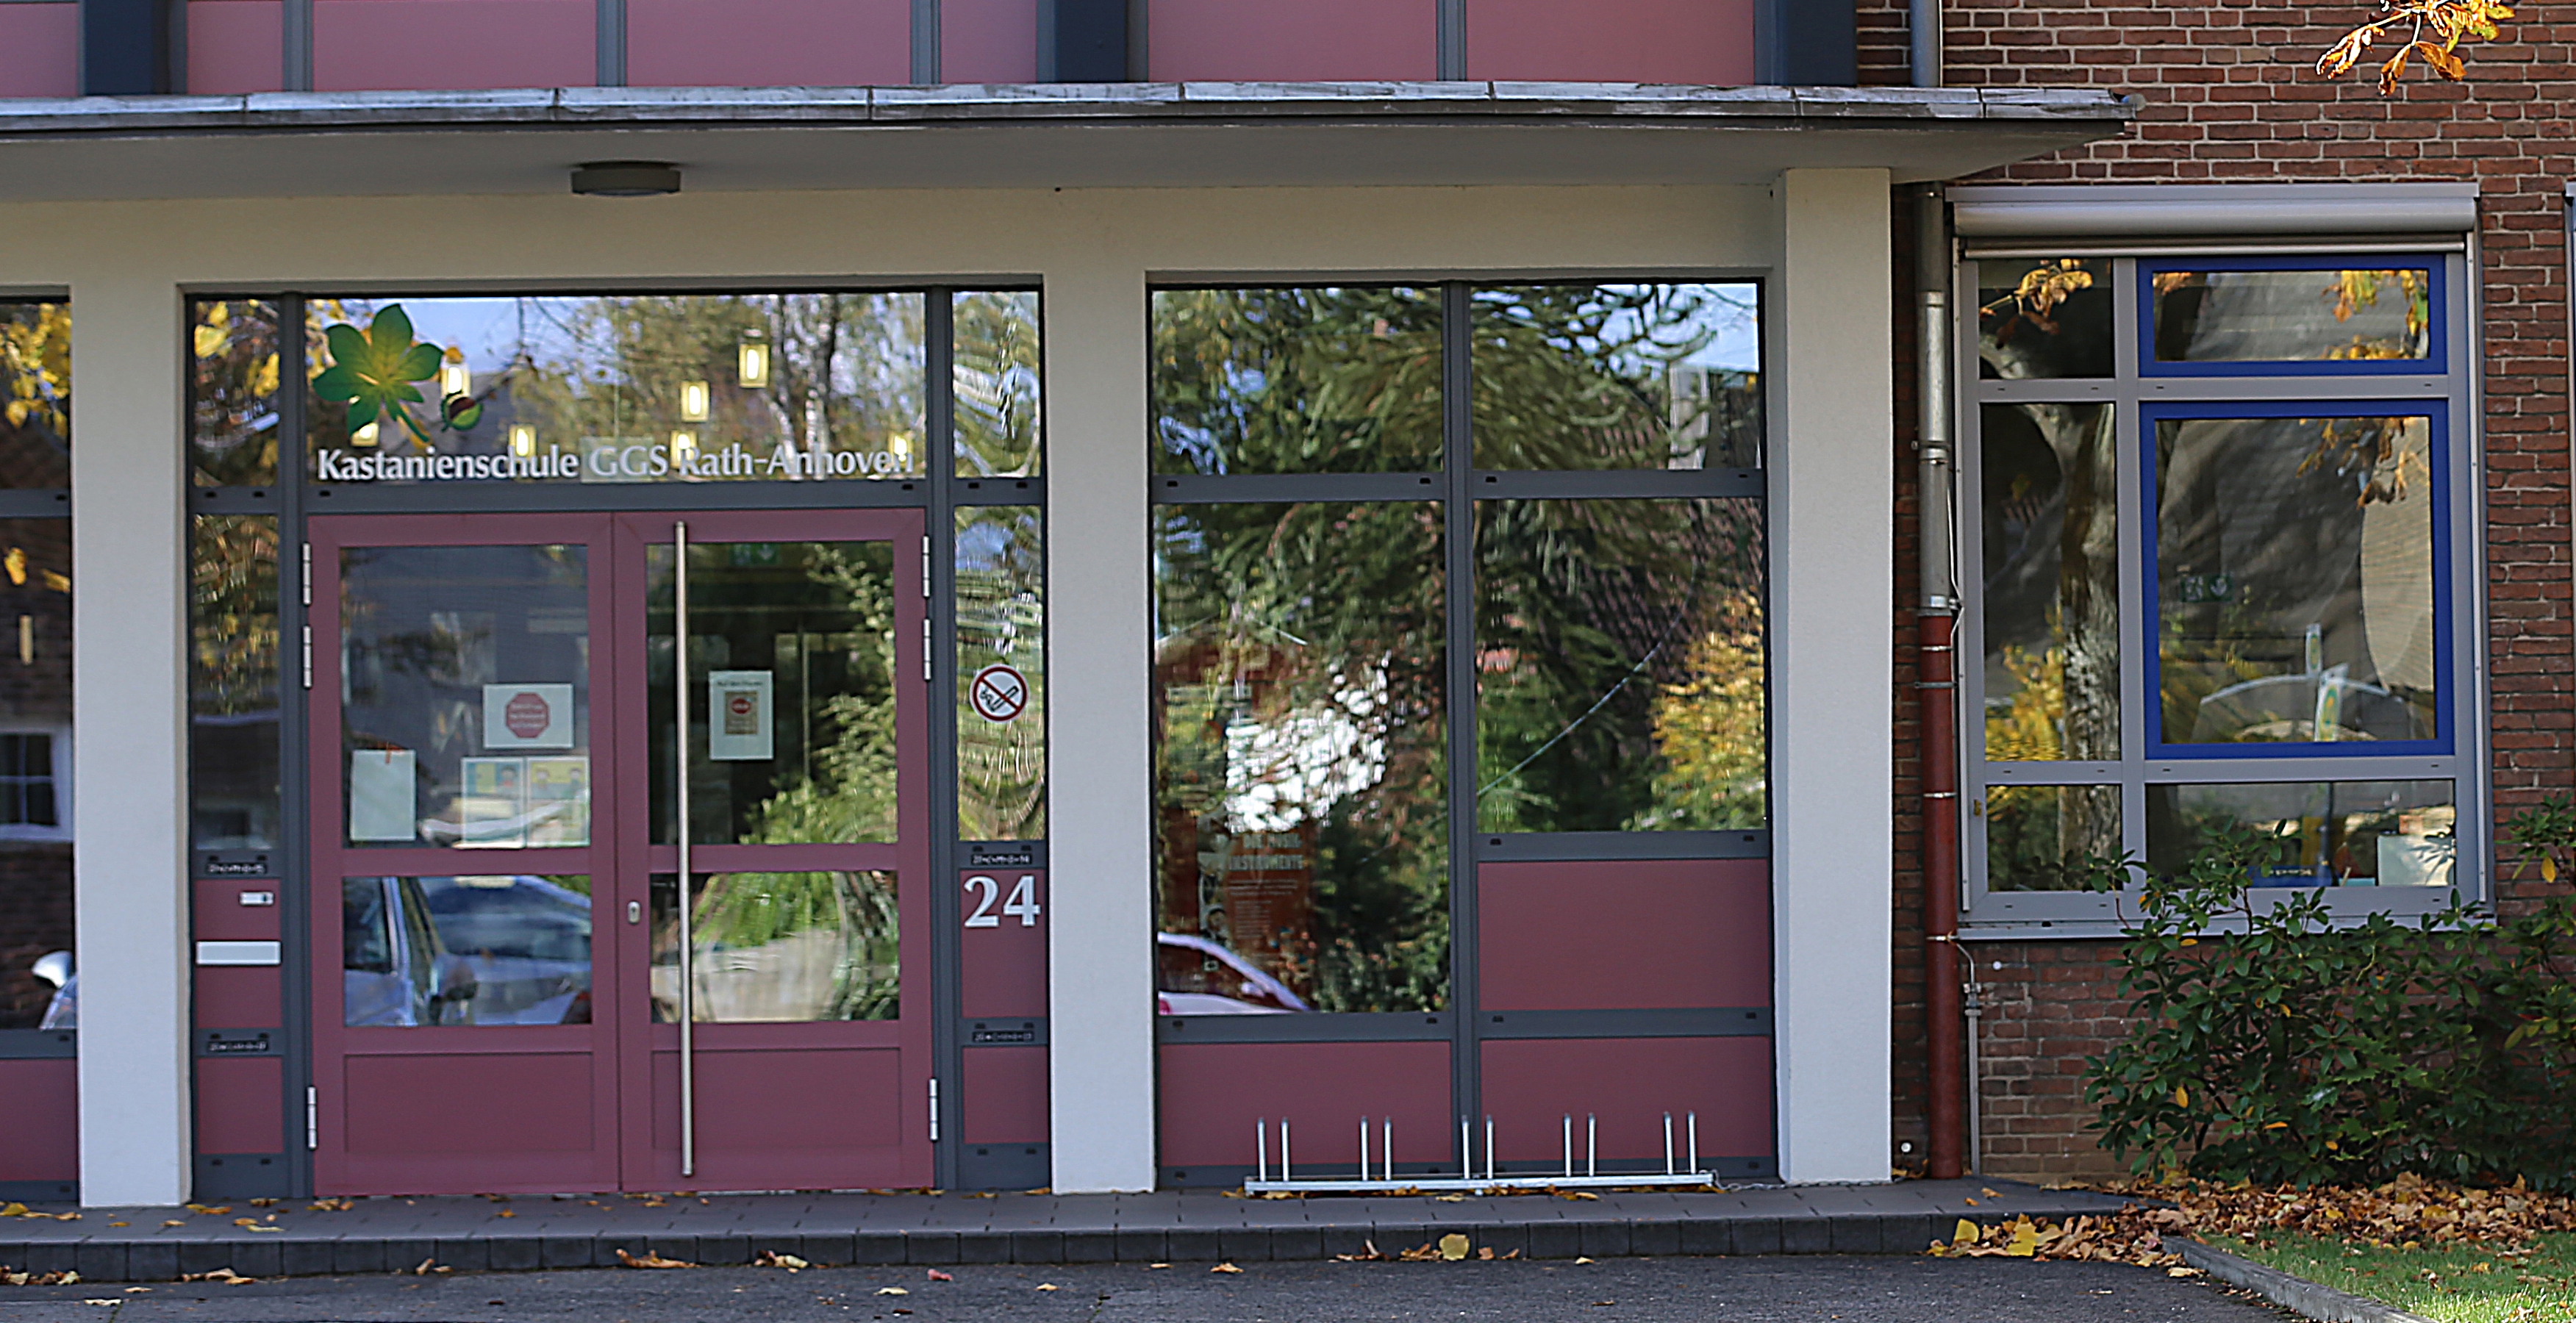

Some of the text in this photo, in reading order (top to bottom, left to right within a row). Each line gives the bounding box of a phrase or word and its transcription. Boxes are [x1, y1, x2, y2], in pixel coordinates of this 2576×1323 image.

[318, 442, 913, 479] Kastanienschule GGS Rath-Anhoven
[964, 875, 1042, 927] 24
